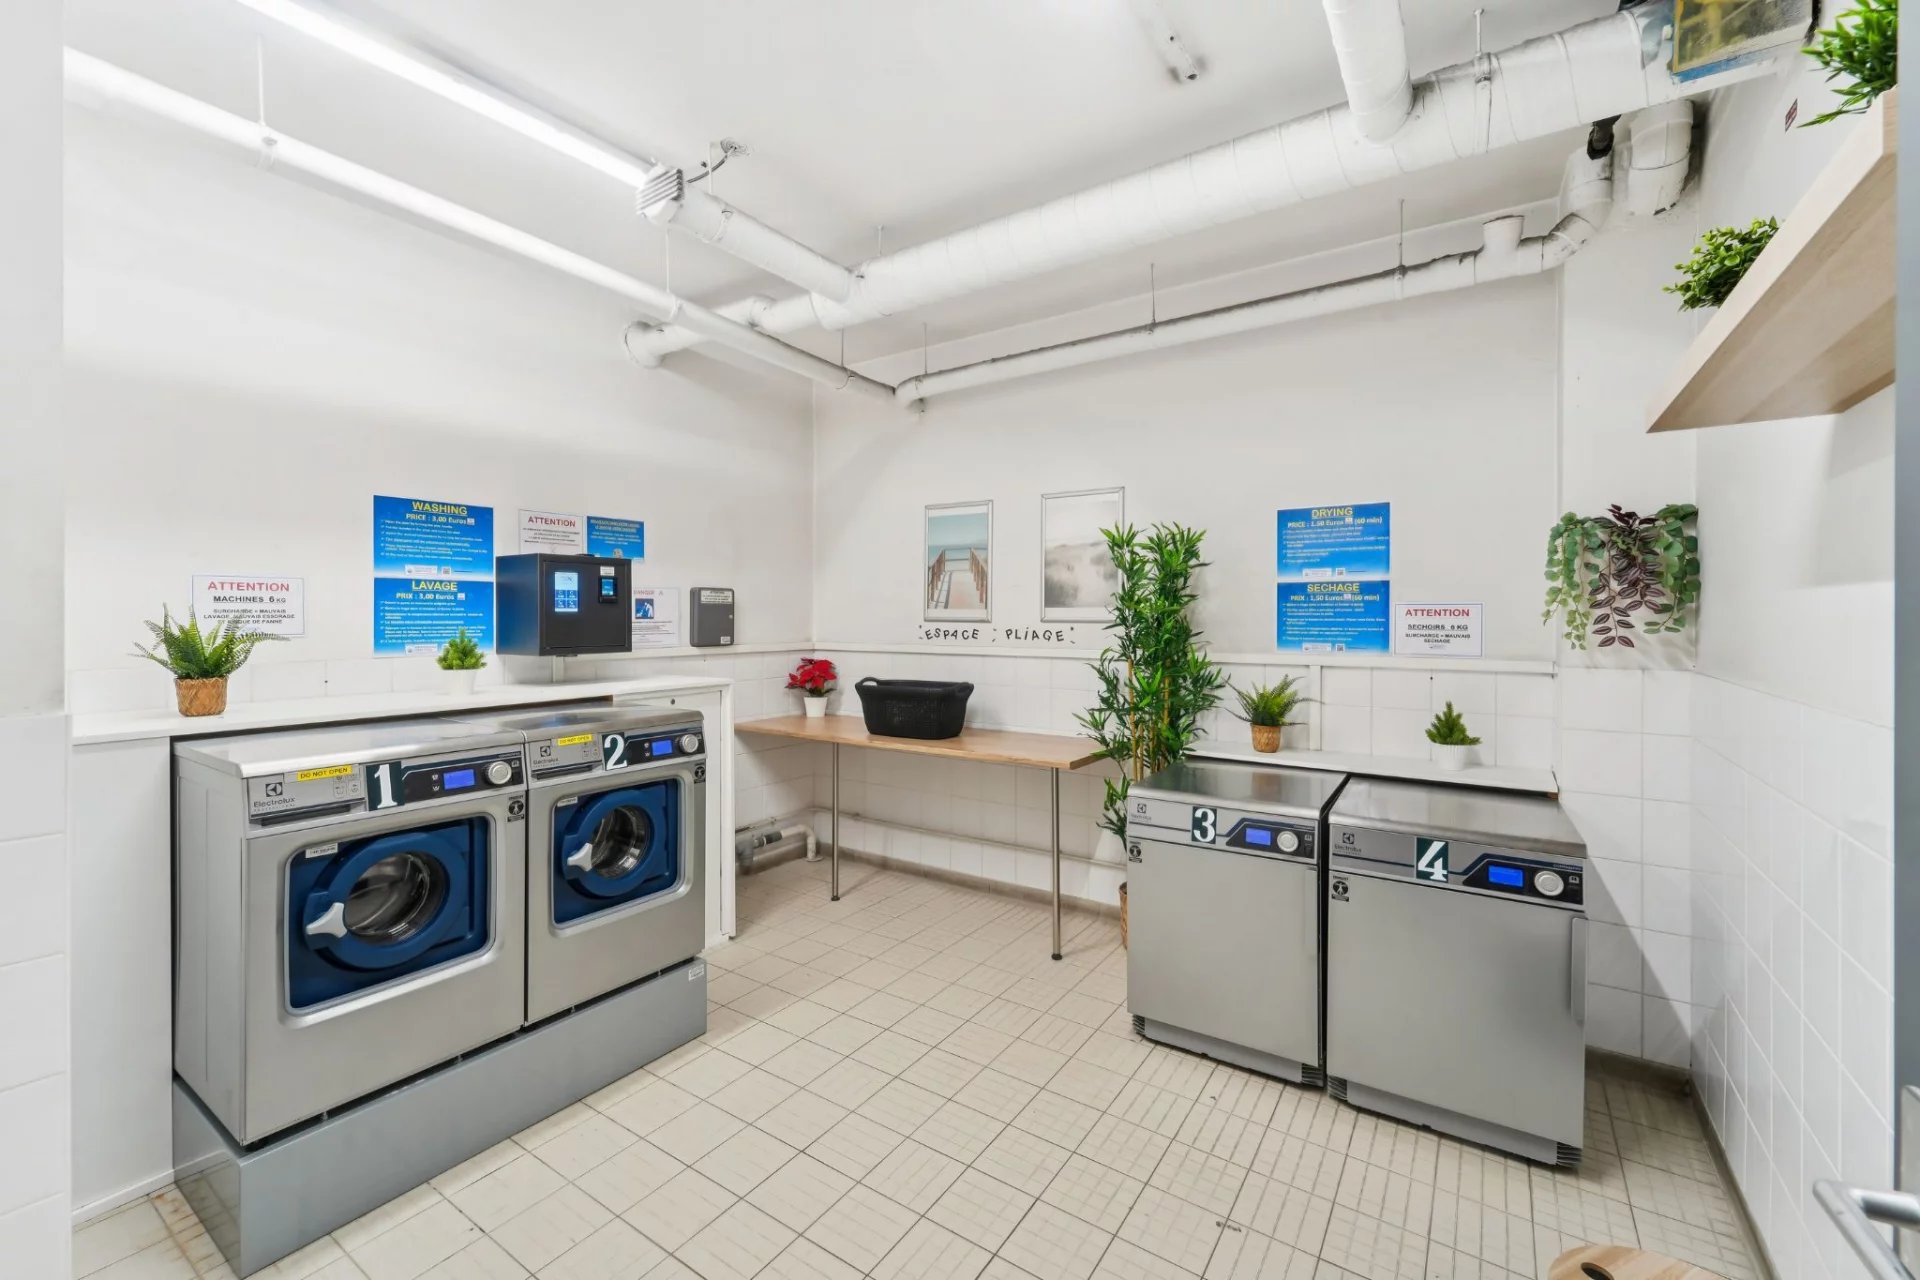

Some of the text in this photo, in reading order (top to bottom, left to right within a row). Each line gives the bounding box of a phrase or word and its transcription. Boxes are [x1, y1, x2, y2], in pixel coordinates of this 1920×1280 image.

[412, 501, 468, 515] WASHING
[1312, 507, 1353, 518] DRYING
[406, 513, 426, 521] PRICE
[528, 516, 576, 528] ATTENTION
[208, 581, 290, 592] ATTENTION
[412, 580, 458, 591] LAVAGE
[1307, 583, 1360, 592] SECHAGE
[213, 595, 264, 603] MACHINES
[268, 595, 275, 603] 6
[1405, 608, 1470, 617] ATTENTION
[925, 628, 980, 640] ESPACE
[604, 734, 628, 771] 2
[330, 767, 348, 775] OPEN
[374, 763, 398, 809] 1
[253, 797, 296, 808] Electrolux
[1193, 807, 1216, 843] 3
[1417, 840, 1448, 882] 4
